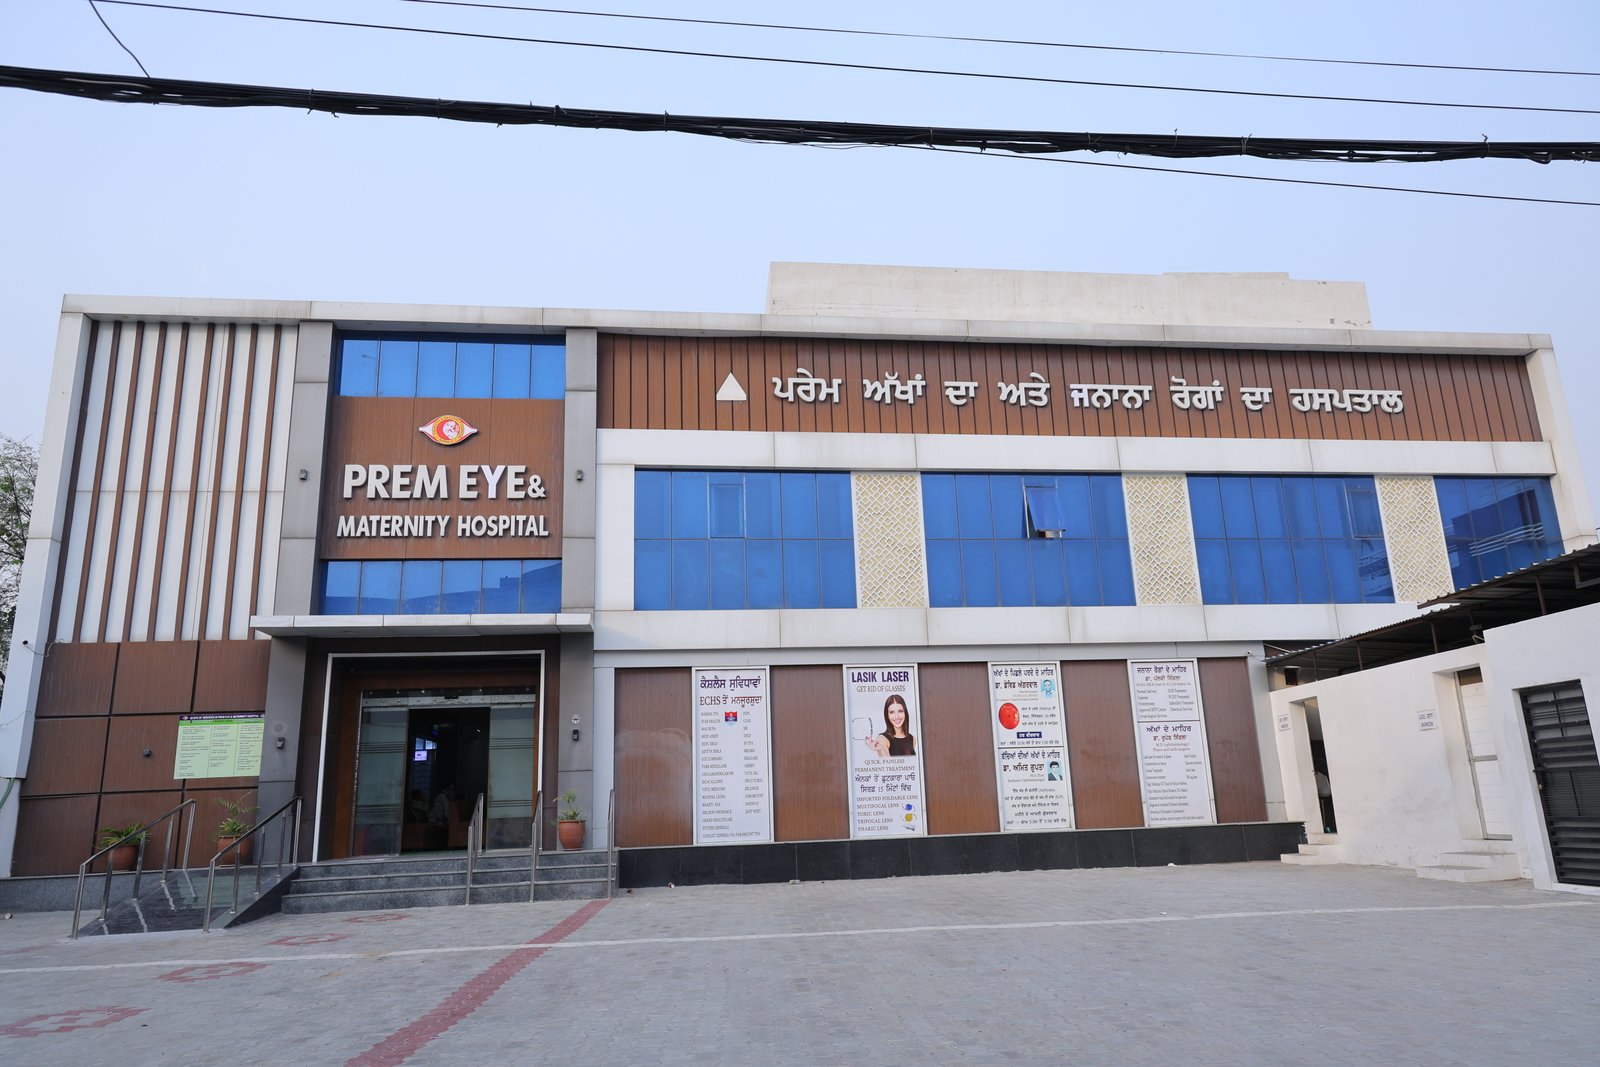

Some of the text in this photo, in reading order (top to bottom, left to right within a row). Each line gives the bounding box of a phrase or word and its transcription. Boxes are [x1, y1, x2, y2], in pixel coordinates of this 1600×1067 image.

[772, 367, 1404, 414] ਪਰੇਮ ਅੱਖਾਂ ਦਾ ਅਤੇ ਜਨਾਨਾ ਰੋਗਾਂ ਦਾ ਹਸਪਤਾਲ
[343, 464, 449, 500] PREM
[336, 515, 549, 537] MATERNITY HOSPITAL
[852, 671, 909, 682] LASIK LASER
[700, 696, 720, 705] ECHS
